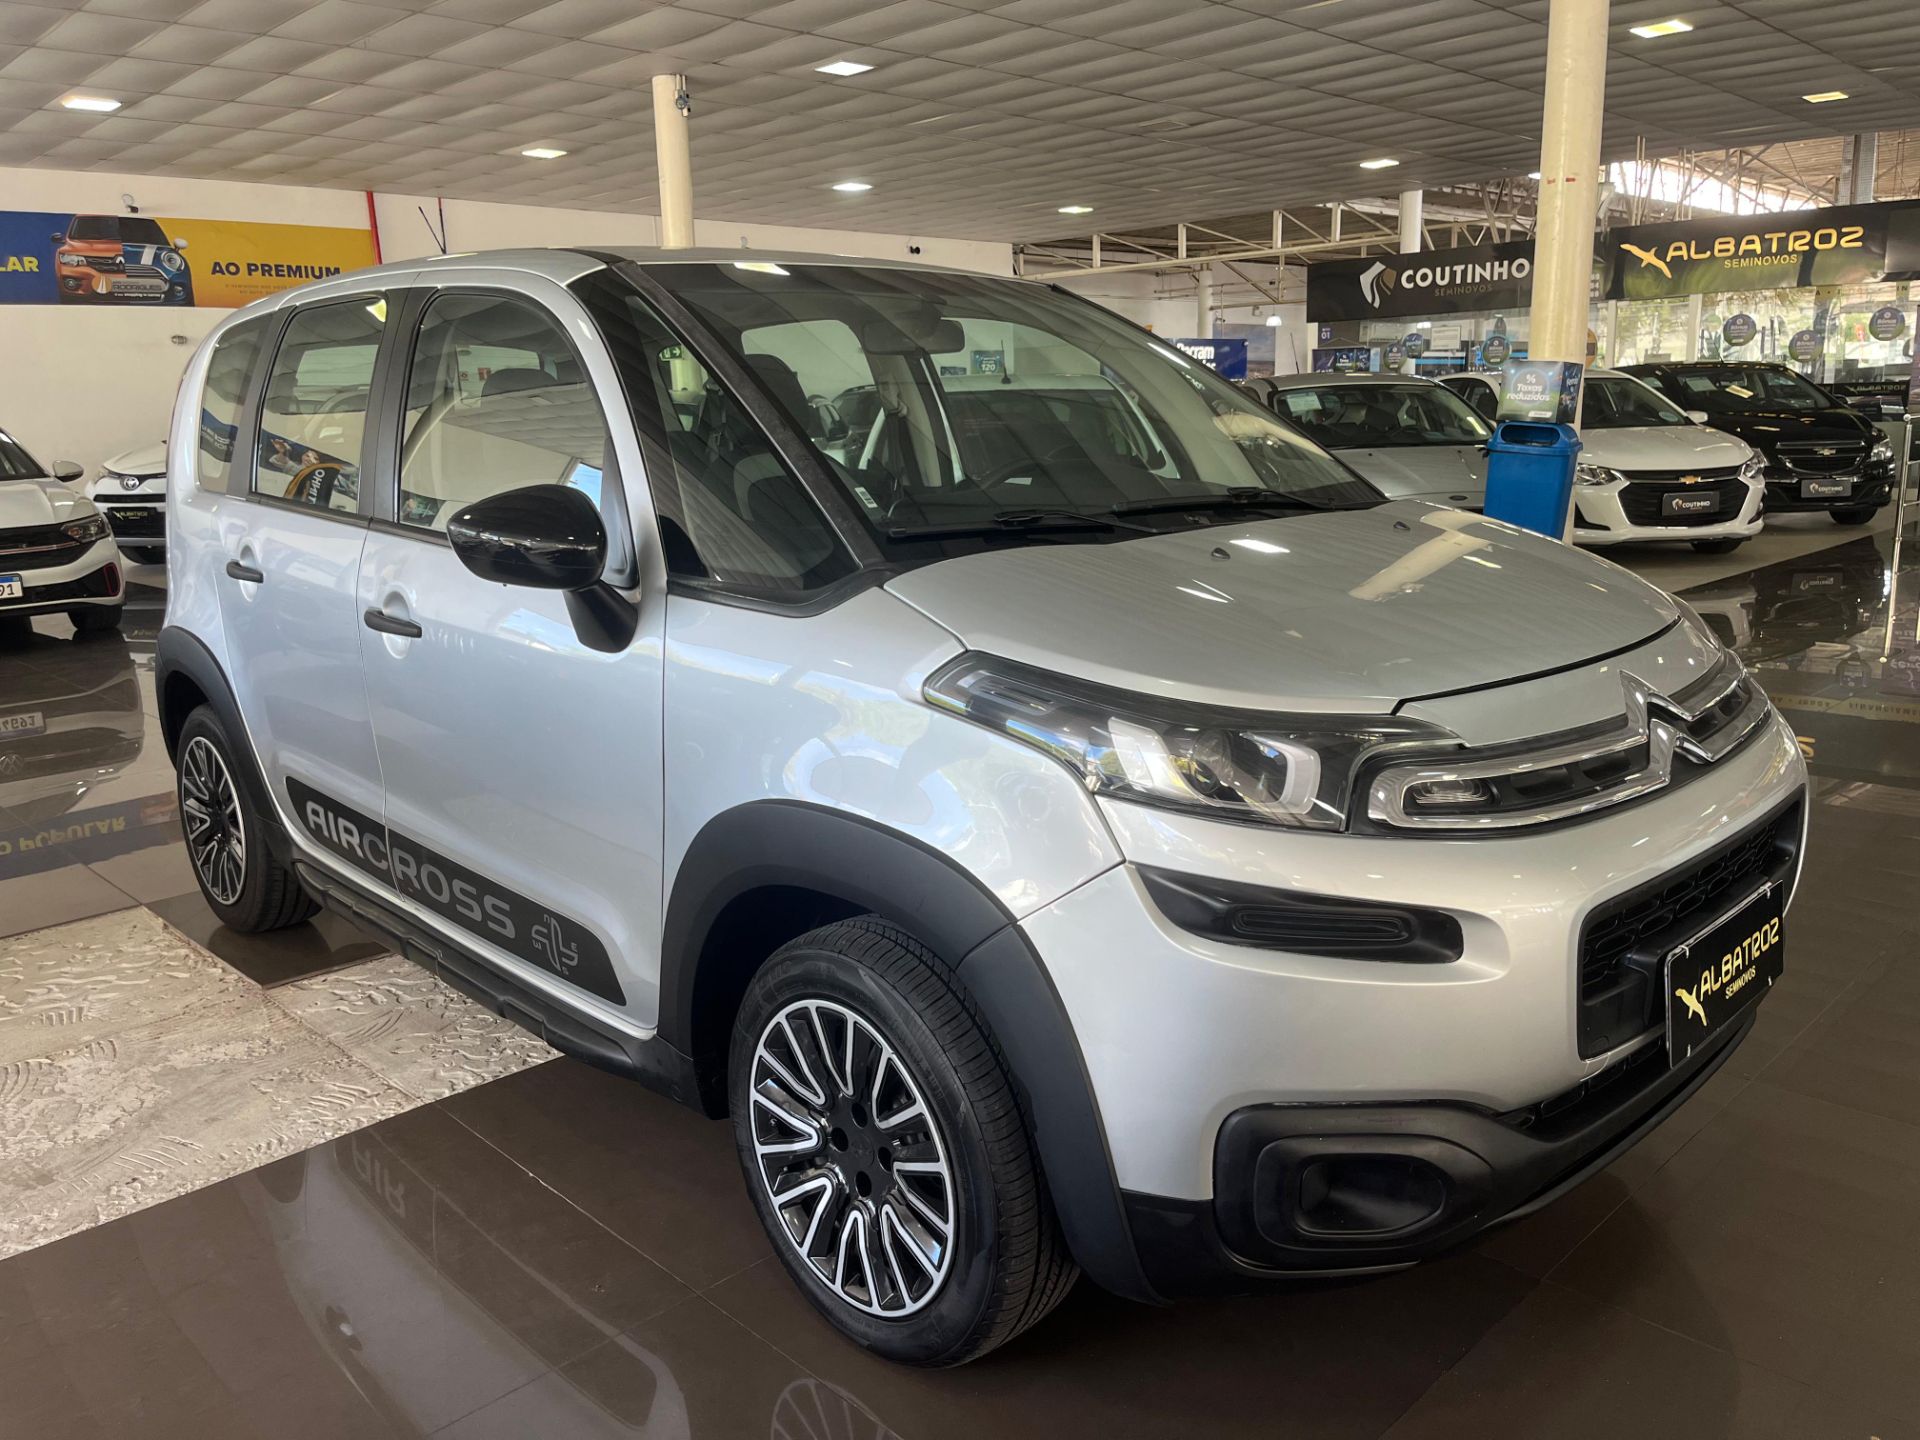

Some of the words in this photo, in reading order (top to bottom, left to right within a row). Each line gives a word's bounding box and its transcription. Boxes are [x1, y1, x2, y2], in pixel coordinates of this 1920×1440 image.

[1666, 226, 1864, 262] ALBATROZ
[211, 261, 240, 276] AO
[247, 262, 340, 279] PREMIUM
[1724, 254, 1798, 269] SEMINOVOS
[1401, 257, 1530, 290] COUTINHO
[1434, 284, 1493, 297] SEMINOVOS
[1506, 391, 1550, 401] reduzidas
[1516, 383, 1543, 392] Taxas
[1682, 500, 1711, 508] COUTINHO
[306, 800, 516, 939] AIRCROSS
[1700, 916, 1779, 1002] ALBATROZ
[1725, 965, 1757, 999] SEMINOVOS
